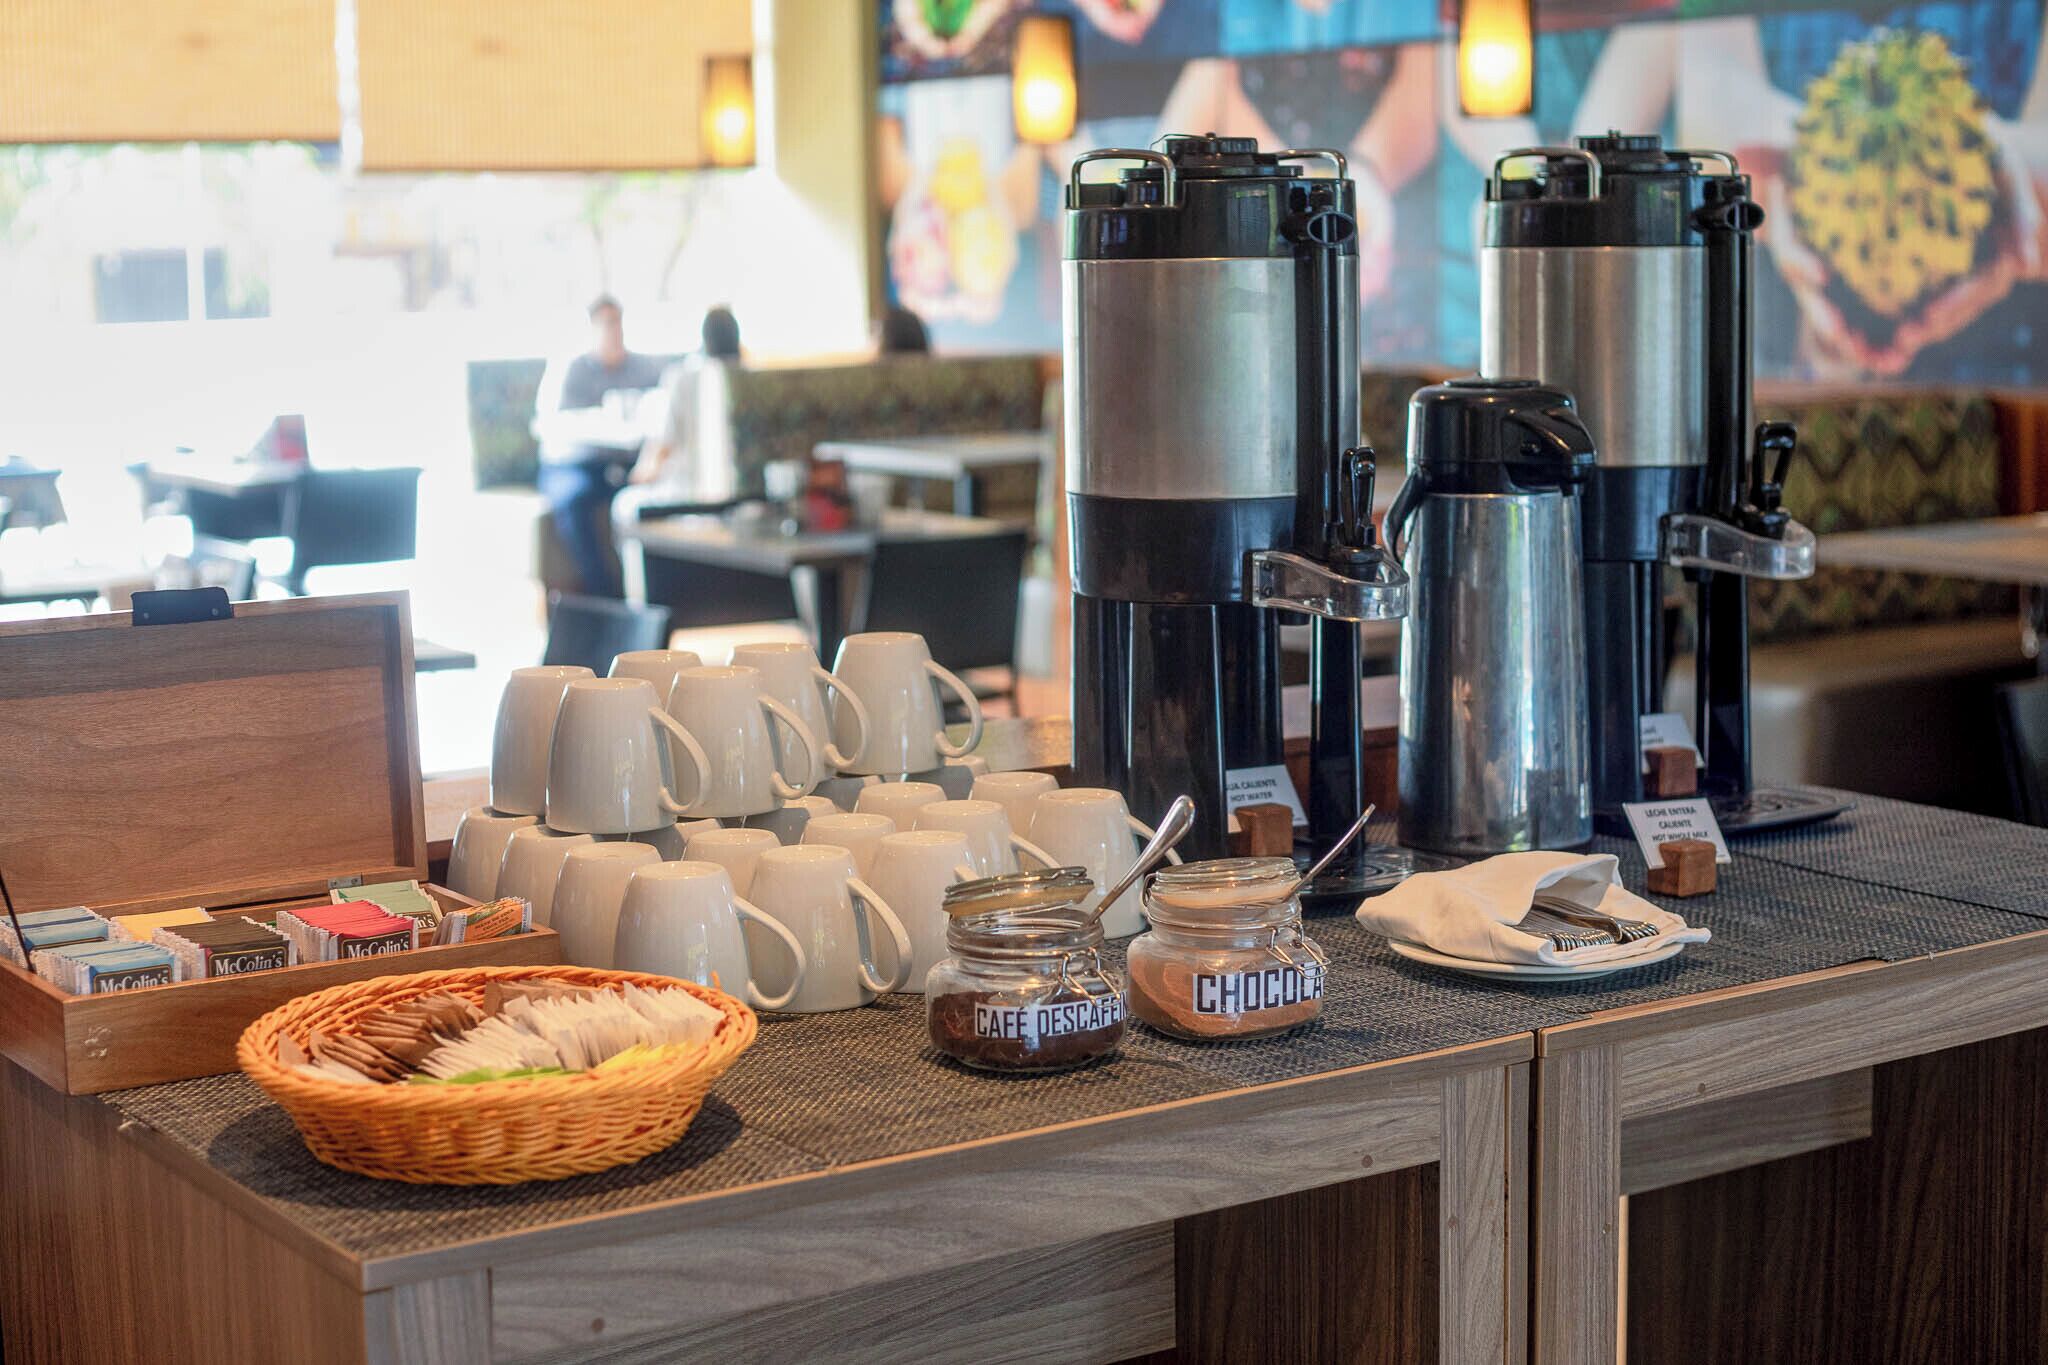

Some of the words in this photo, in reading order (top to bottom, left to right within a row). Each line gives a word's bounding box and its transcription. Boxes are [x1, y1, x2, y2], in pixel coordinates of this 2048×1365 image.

[1241, 779, 1277, 789] CALIENTE
[1231, 794, 1245, 802] HOT
[1247, 791, 1273, 801] WATER
[1644, 808, 1667, 818] LECHE
[1668, 806, 1697, 816] ENTERA
[1658, 819, 1692, 829] CALIENTE
[1652, 833, 1666, 841] HOT
[1668, 831, 1691, 841] WHOLE
[347, 938, 409, 959] McColin's
[214, 954, 282, 976] McColin's
[100, 973, 168, 993] McColin's
[1197, 962, 1322, 1013] CHOCOLA
[976, 1007, 1029, 1039] CAFÉ
